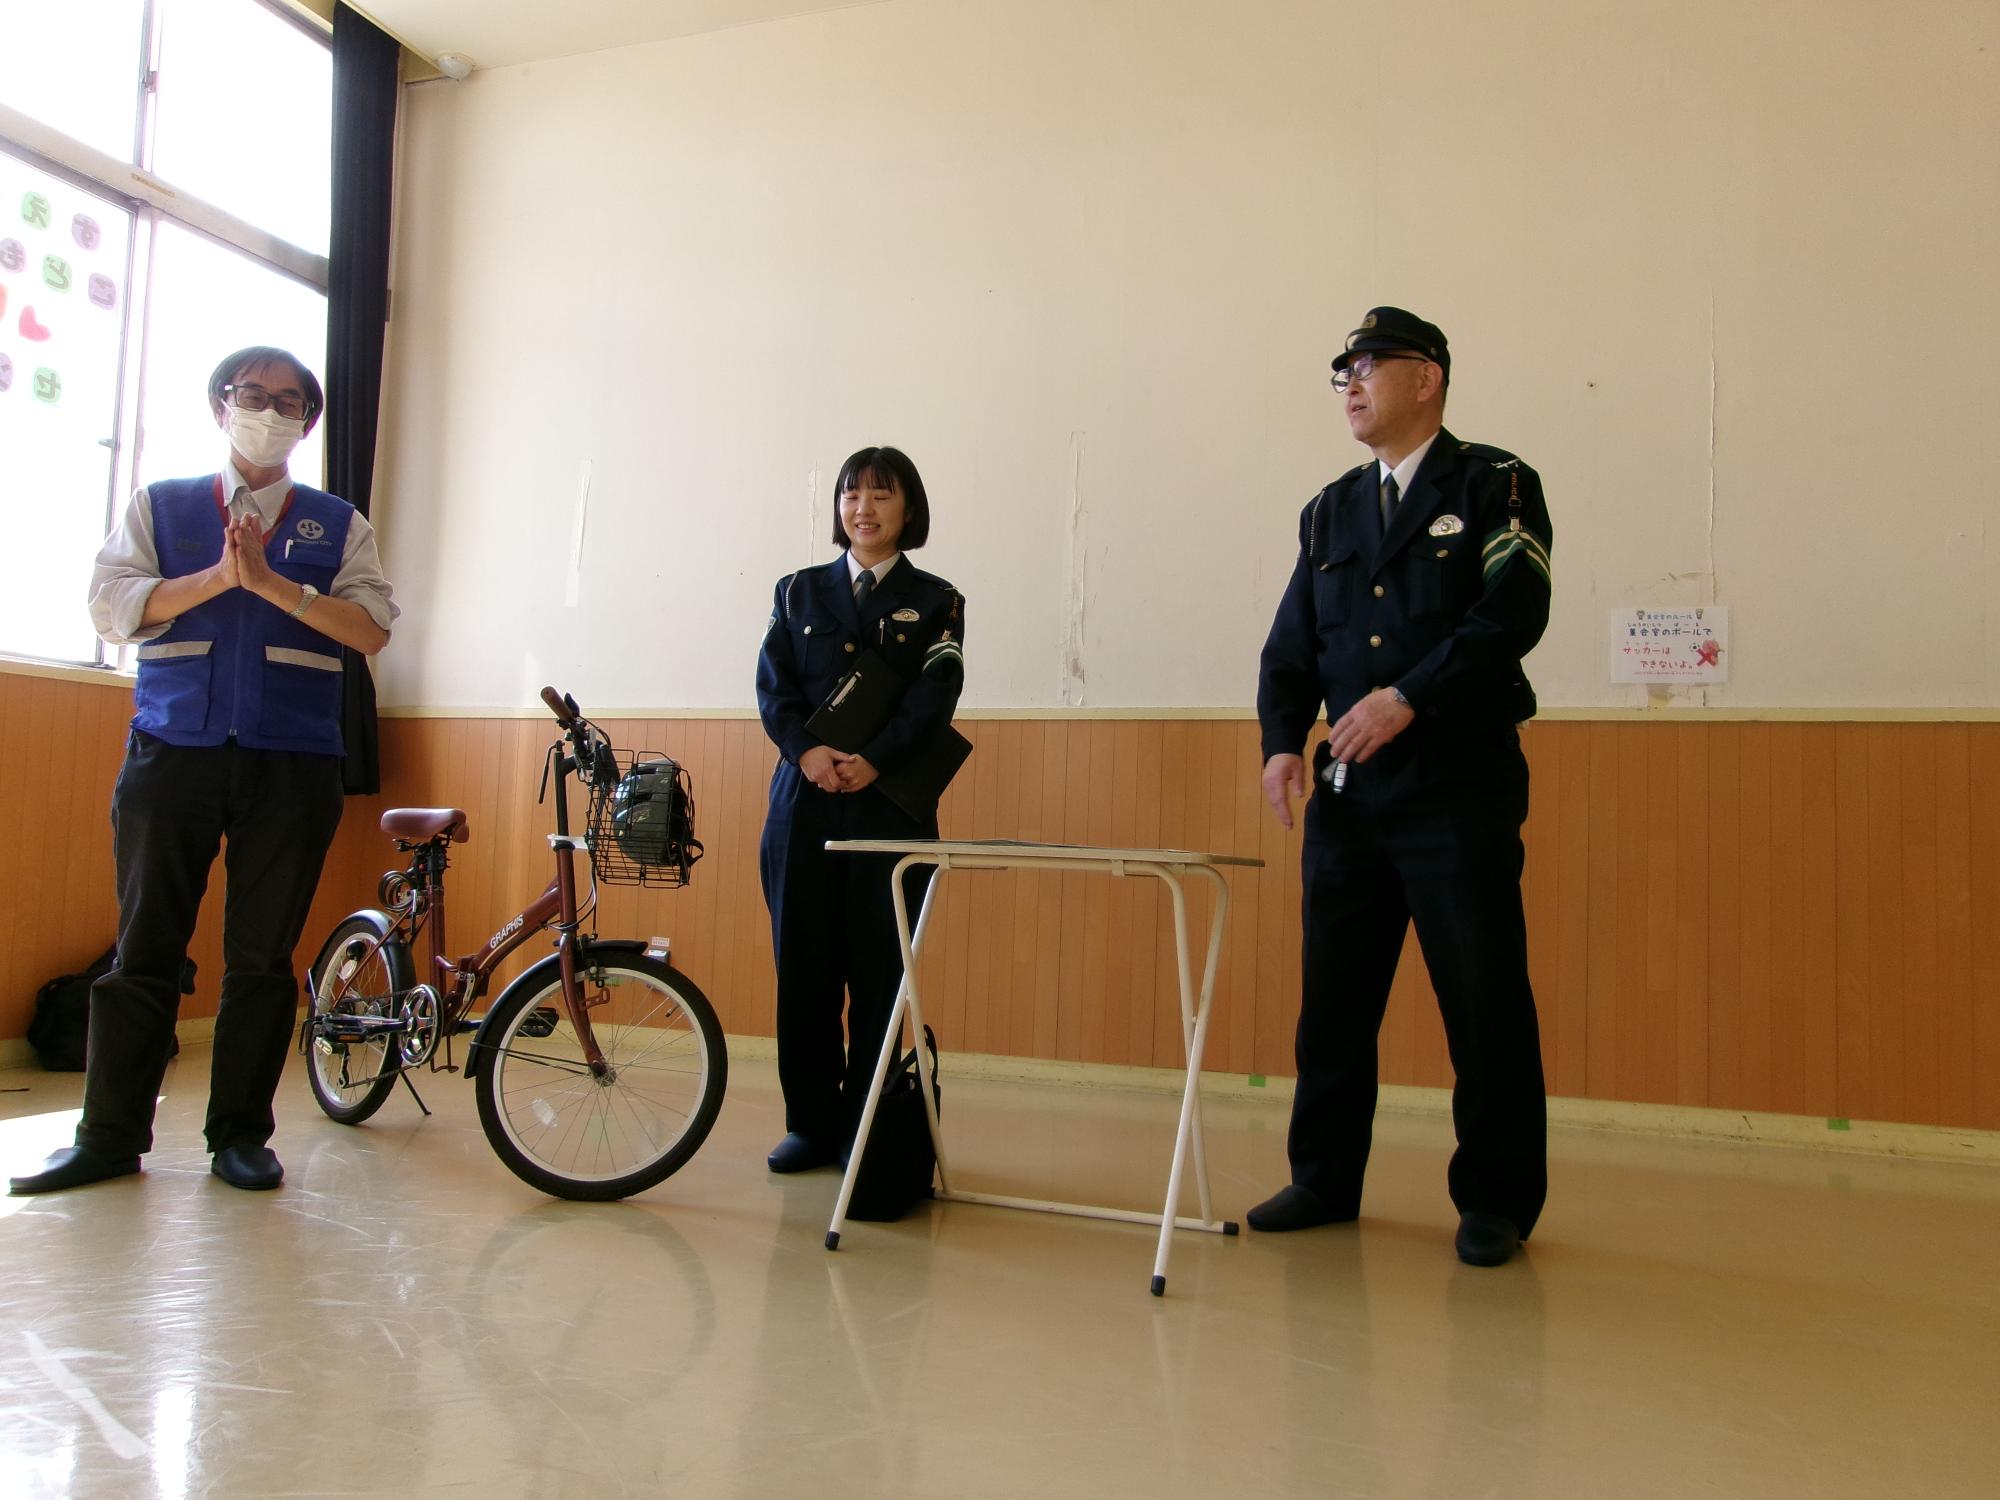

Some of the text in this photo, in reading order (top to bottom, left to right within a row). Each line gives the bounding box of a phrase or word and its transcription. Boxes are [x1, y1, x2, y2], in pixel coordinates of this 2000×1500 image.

[1623, 646, 1670, 654] サッカーは
[1640, 660, 1693, 669] できないよ。
[490, 914, 524, 949] GRAPHIS
